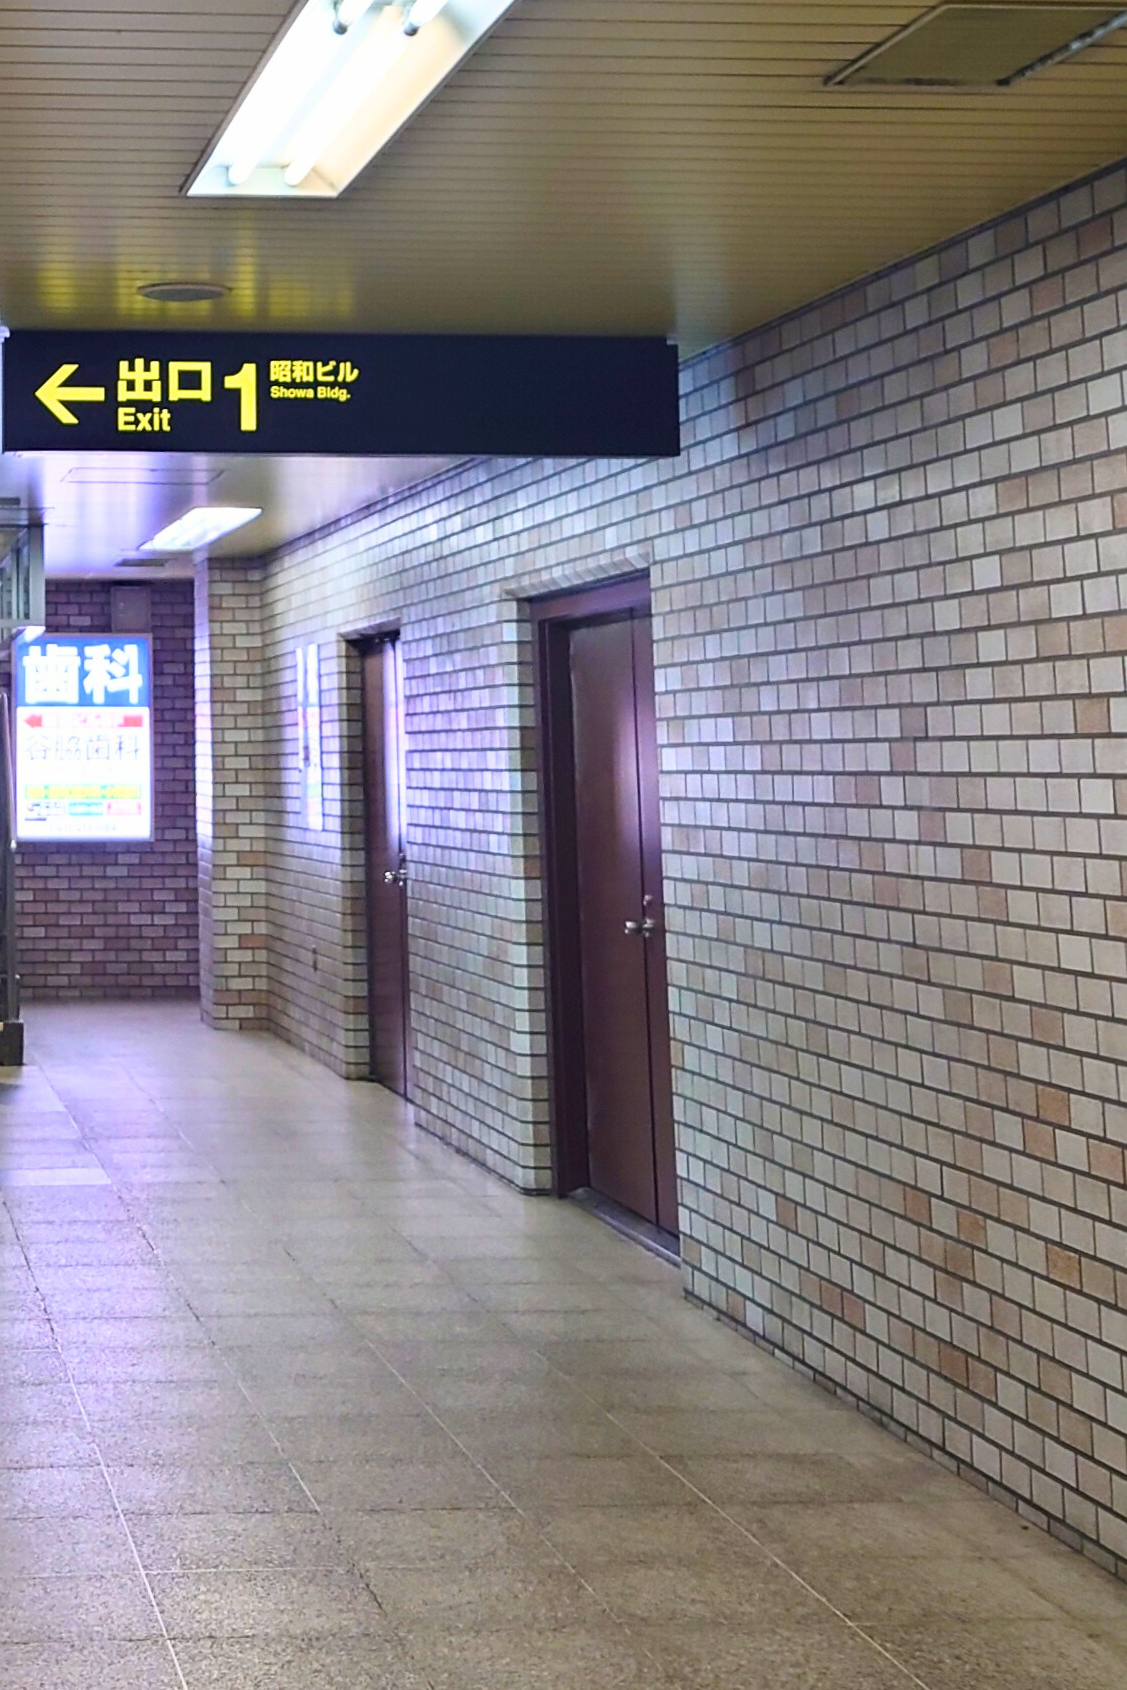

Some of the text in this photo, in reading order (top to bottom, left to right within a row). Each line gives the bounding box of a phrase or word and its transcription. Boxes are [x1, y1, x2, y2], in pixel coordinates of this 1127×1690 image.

[269, 360, 359, 383] 昭和ビル
[117, 357, 257, 432] 出口 1
[270, 385, 350, 402] Showa Bldg.
[117, 406, 171, 432] Exit
[23, 643, 143, 705] 歯科
[25, 734, 140, 761] 谷脇歯科
